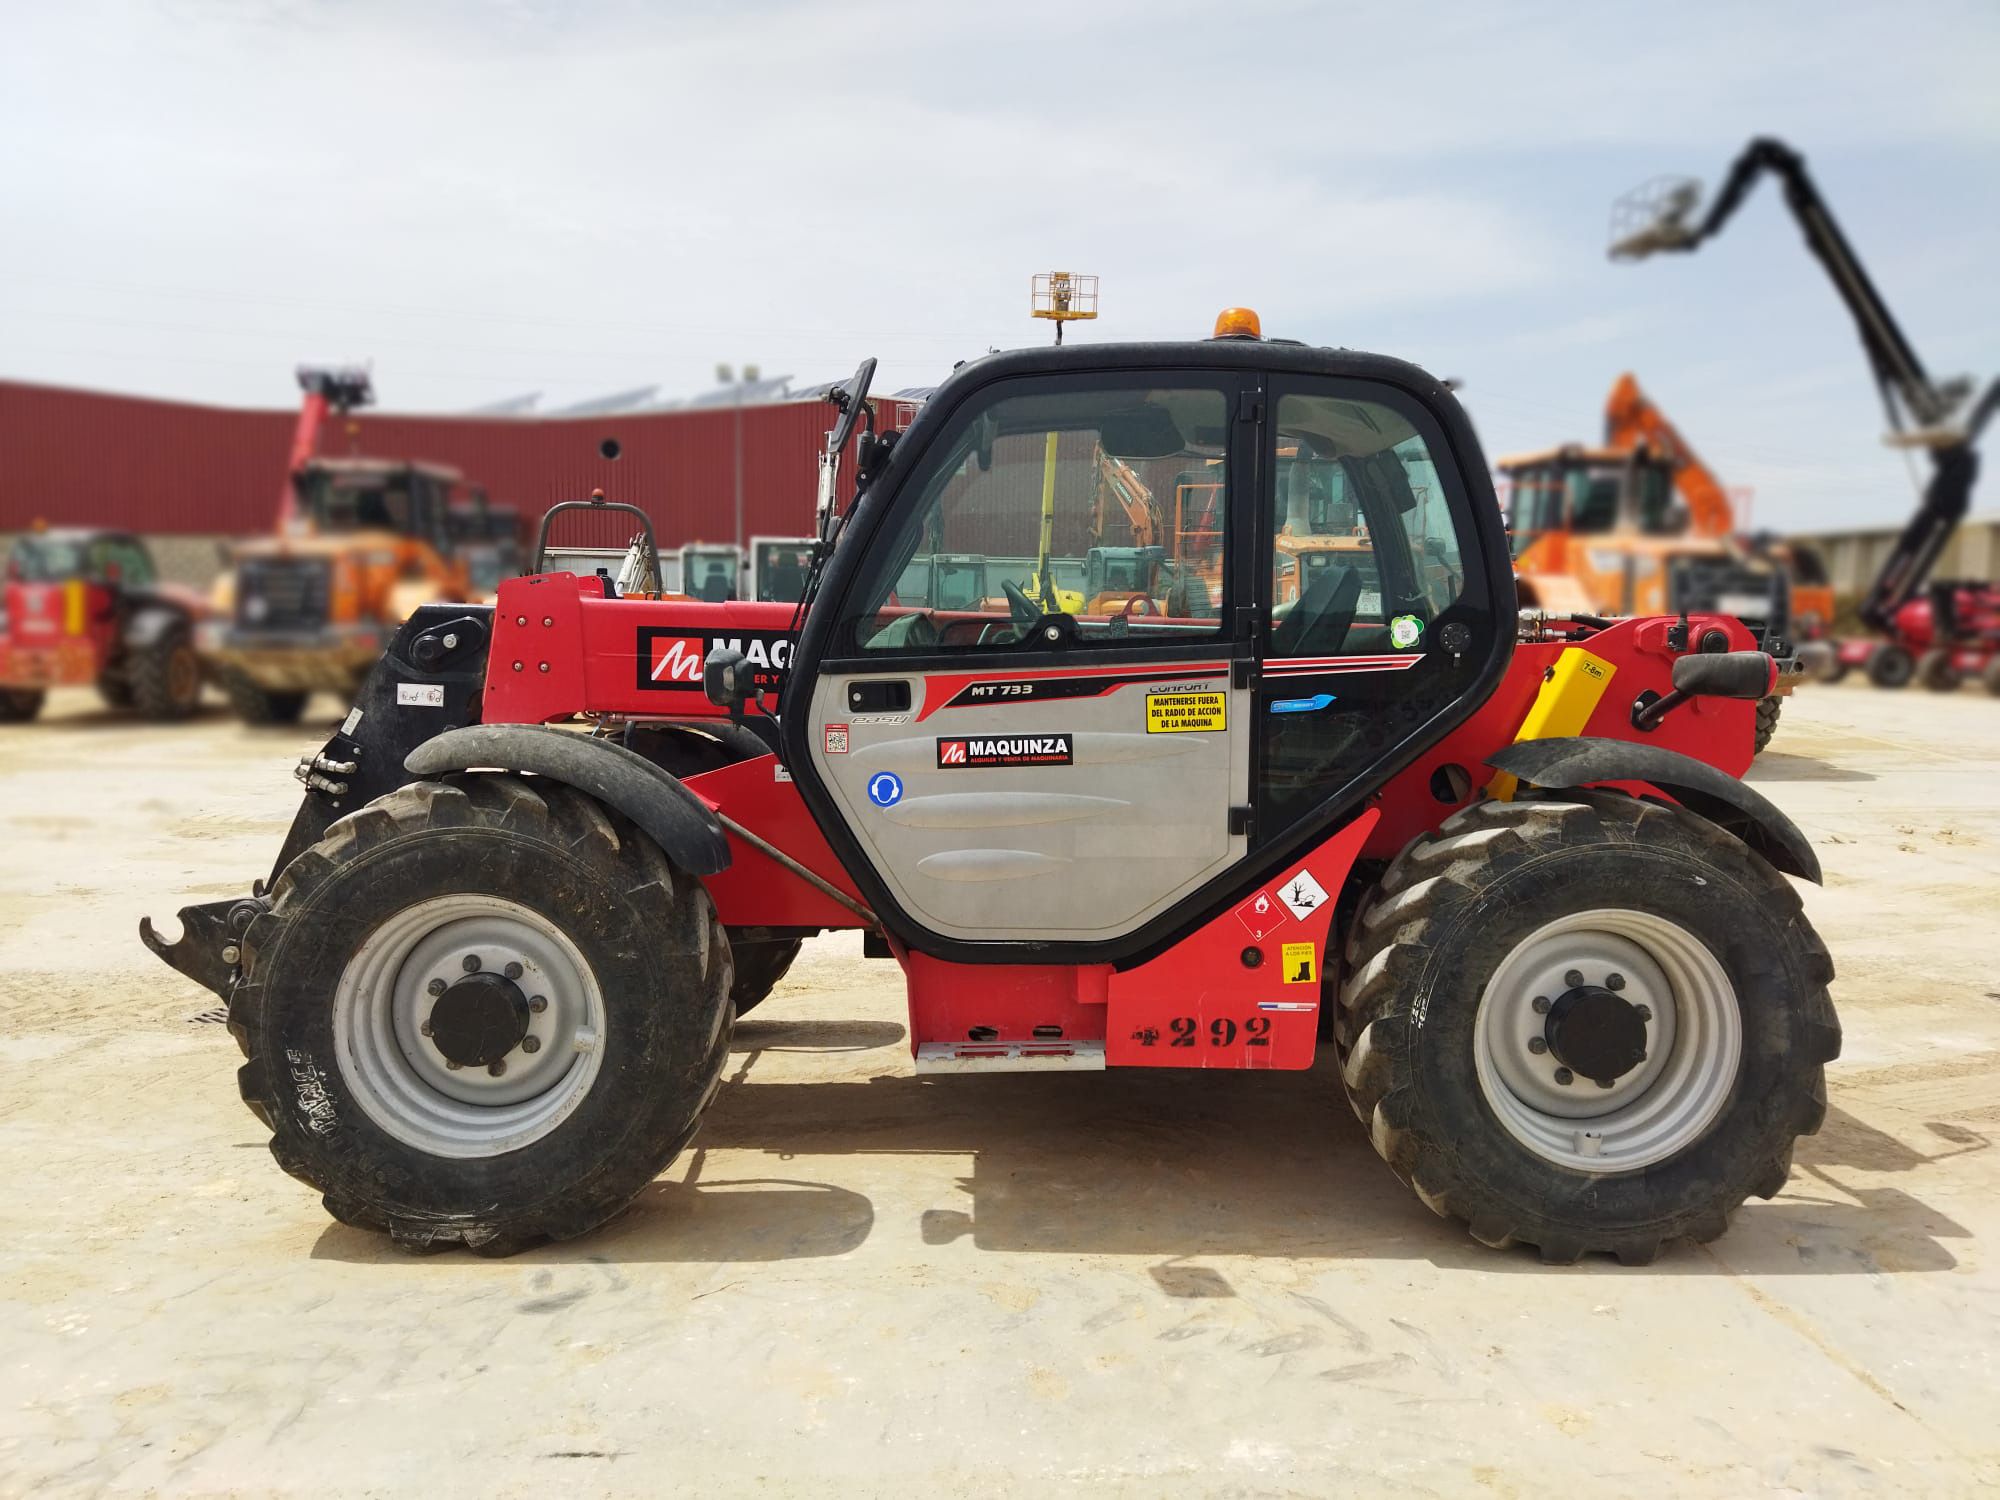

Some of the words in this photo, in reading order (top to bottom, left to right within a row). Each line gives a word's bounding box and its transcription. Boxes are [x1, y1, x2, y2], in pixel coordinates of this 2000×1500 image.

[1583, 662, 1602, 678] 7-8m
[971, 686, 997, 696] MT
[1000, 684, 1033, 695] 733
[1153, 697, 1197, 706] MANTENERSE
[1198, 696, 1219, 704] FUERA
[1151, 709, 1164, 717] DEL
[1165, 708, 1186, 716] RADIO
[1187, 708, 1197, 716] DE
[1197, 707, 1222, 716] ACCION
[851, 715, 911, 726] easy
[1161, 720, 1170, 728] DE
[1181, 719, 1213, 727] MAQUINA
[969, 739, 1068, 756] MAQUINZA
[1256, 930, 1262, 938] 3
